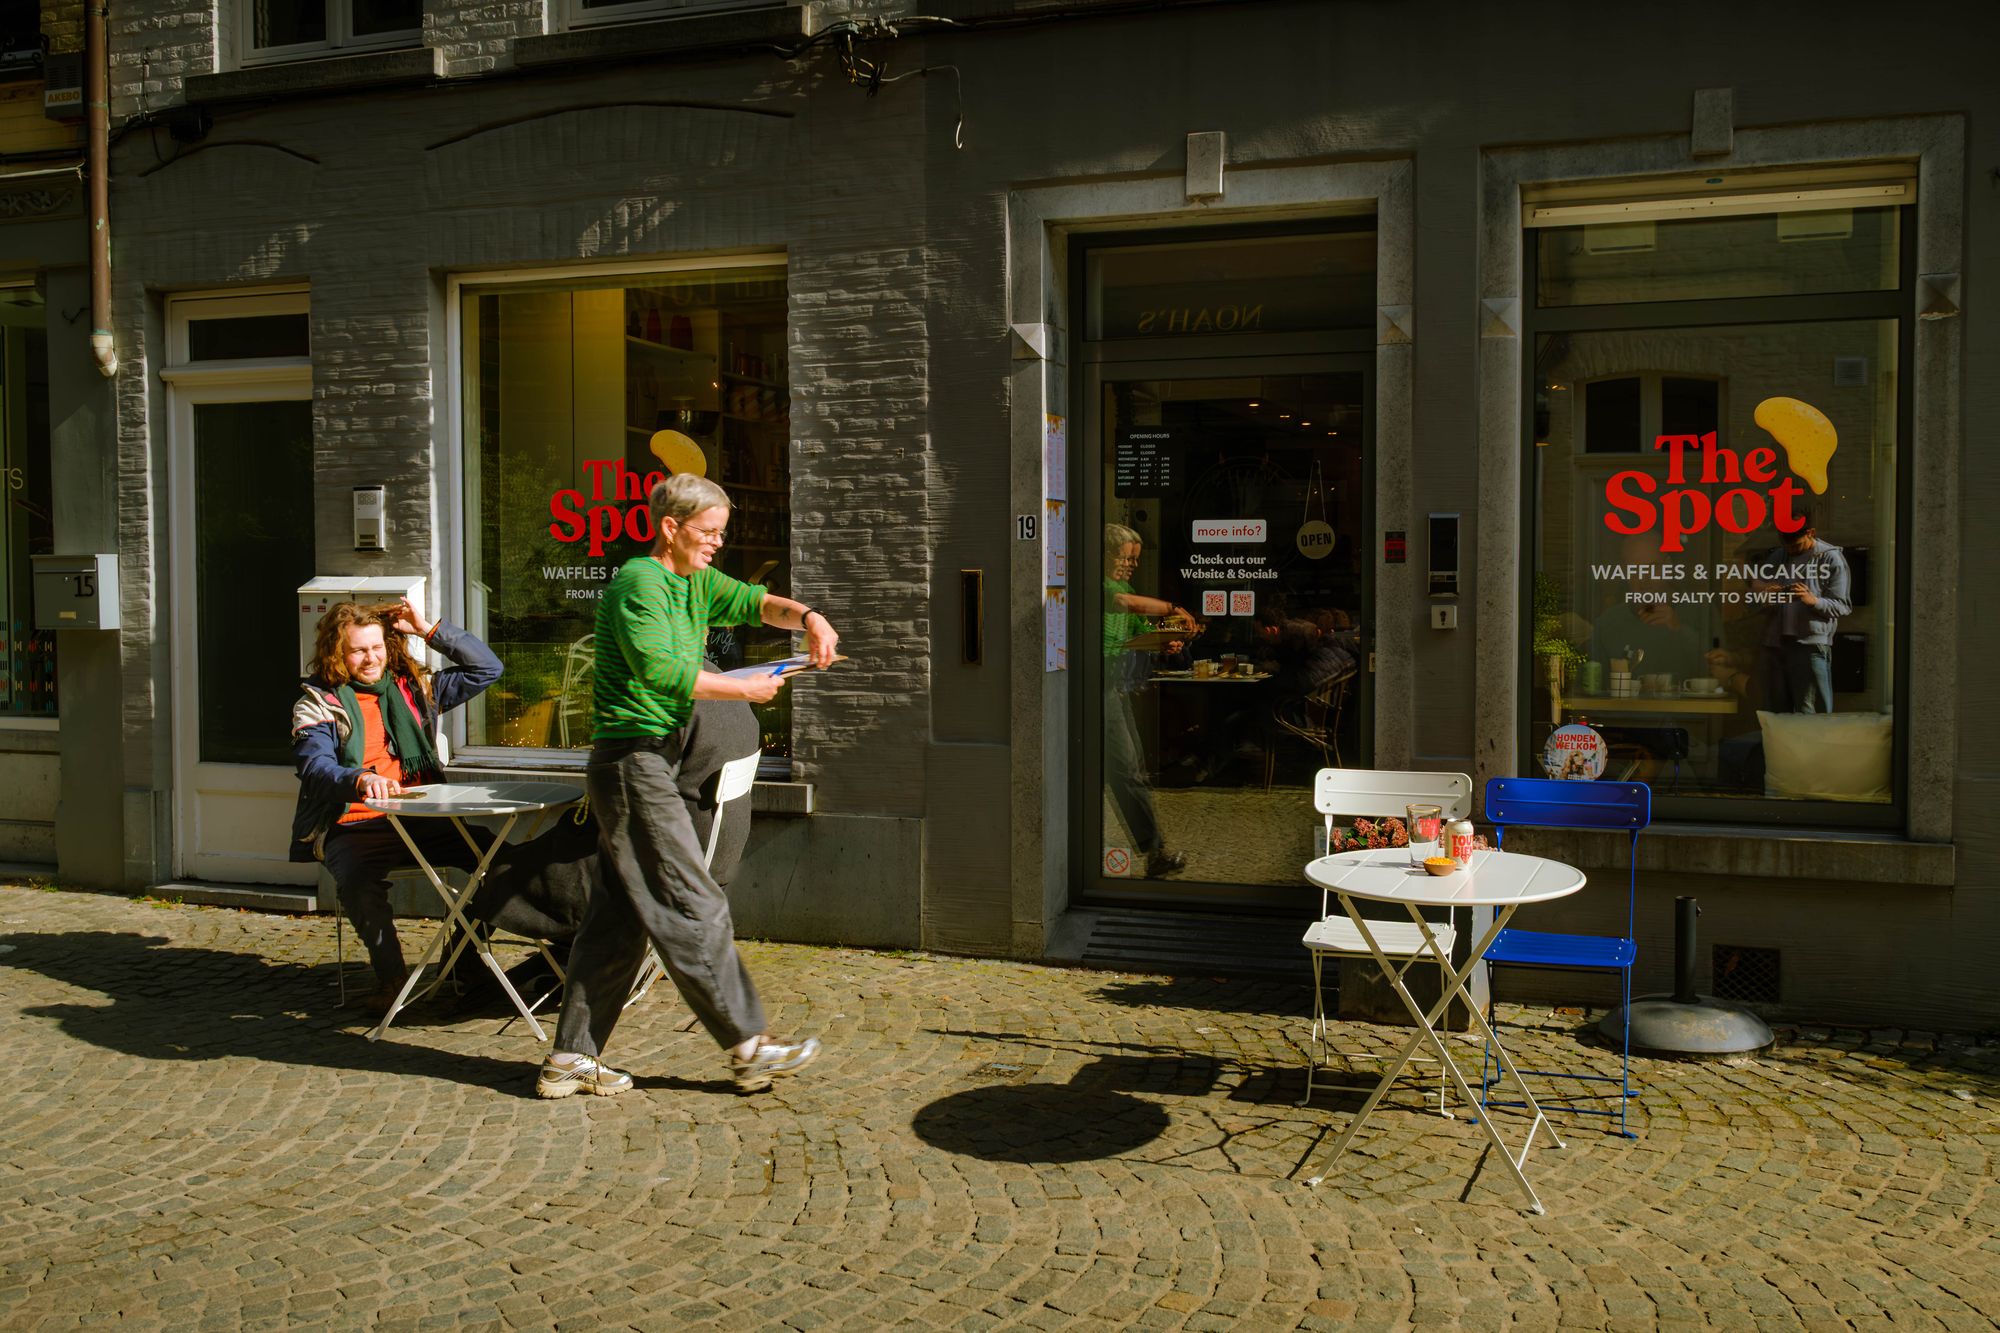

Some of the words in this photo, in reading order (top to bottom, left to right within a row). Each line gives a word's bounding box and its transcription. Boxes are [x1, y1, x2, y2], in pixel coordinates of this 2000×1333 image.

[1654, 431, 1777, 485] The
[1603, 470, 1806, 554] Spot
[549, 489, 657, 558] Spo
[1018, 515, 1036, 539] 19
[1197, 527, 1228, 536] more
[1232, 525, 1262, 536] info?
[1301, 532, 1332, 547] OPEN
[1190, 553, 1225, 565] Check
[1225, 555, 1245, 565] out
[1246, 557, 1267, 565] our
[542, 566, 607, 580] WAFFLES
[1180, 568, 1225, 579] Website
[1226, 568, 1236, 579] &
[1237, 568, 1278, 579] Socials
[1591, 564, 1686, 580] WAFFLES
[1693, 563, 1708, 580] &
[1715, 563, 1831, 580] PANCAKES
[74, 575, 95, 598] 15
[565, 589, 595, 599] FROM
[1625, 591, 1667, 604] FROM
[1671, 591, 1714, 604] SALTY
[1719, 591, 1741, 604] TO
[1744, 591, 1795, 604] SWEET
[1557, 733, 1596, 743] HONDEN
[1555, 742, 1597, 751] WELKOM
